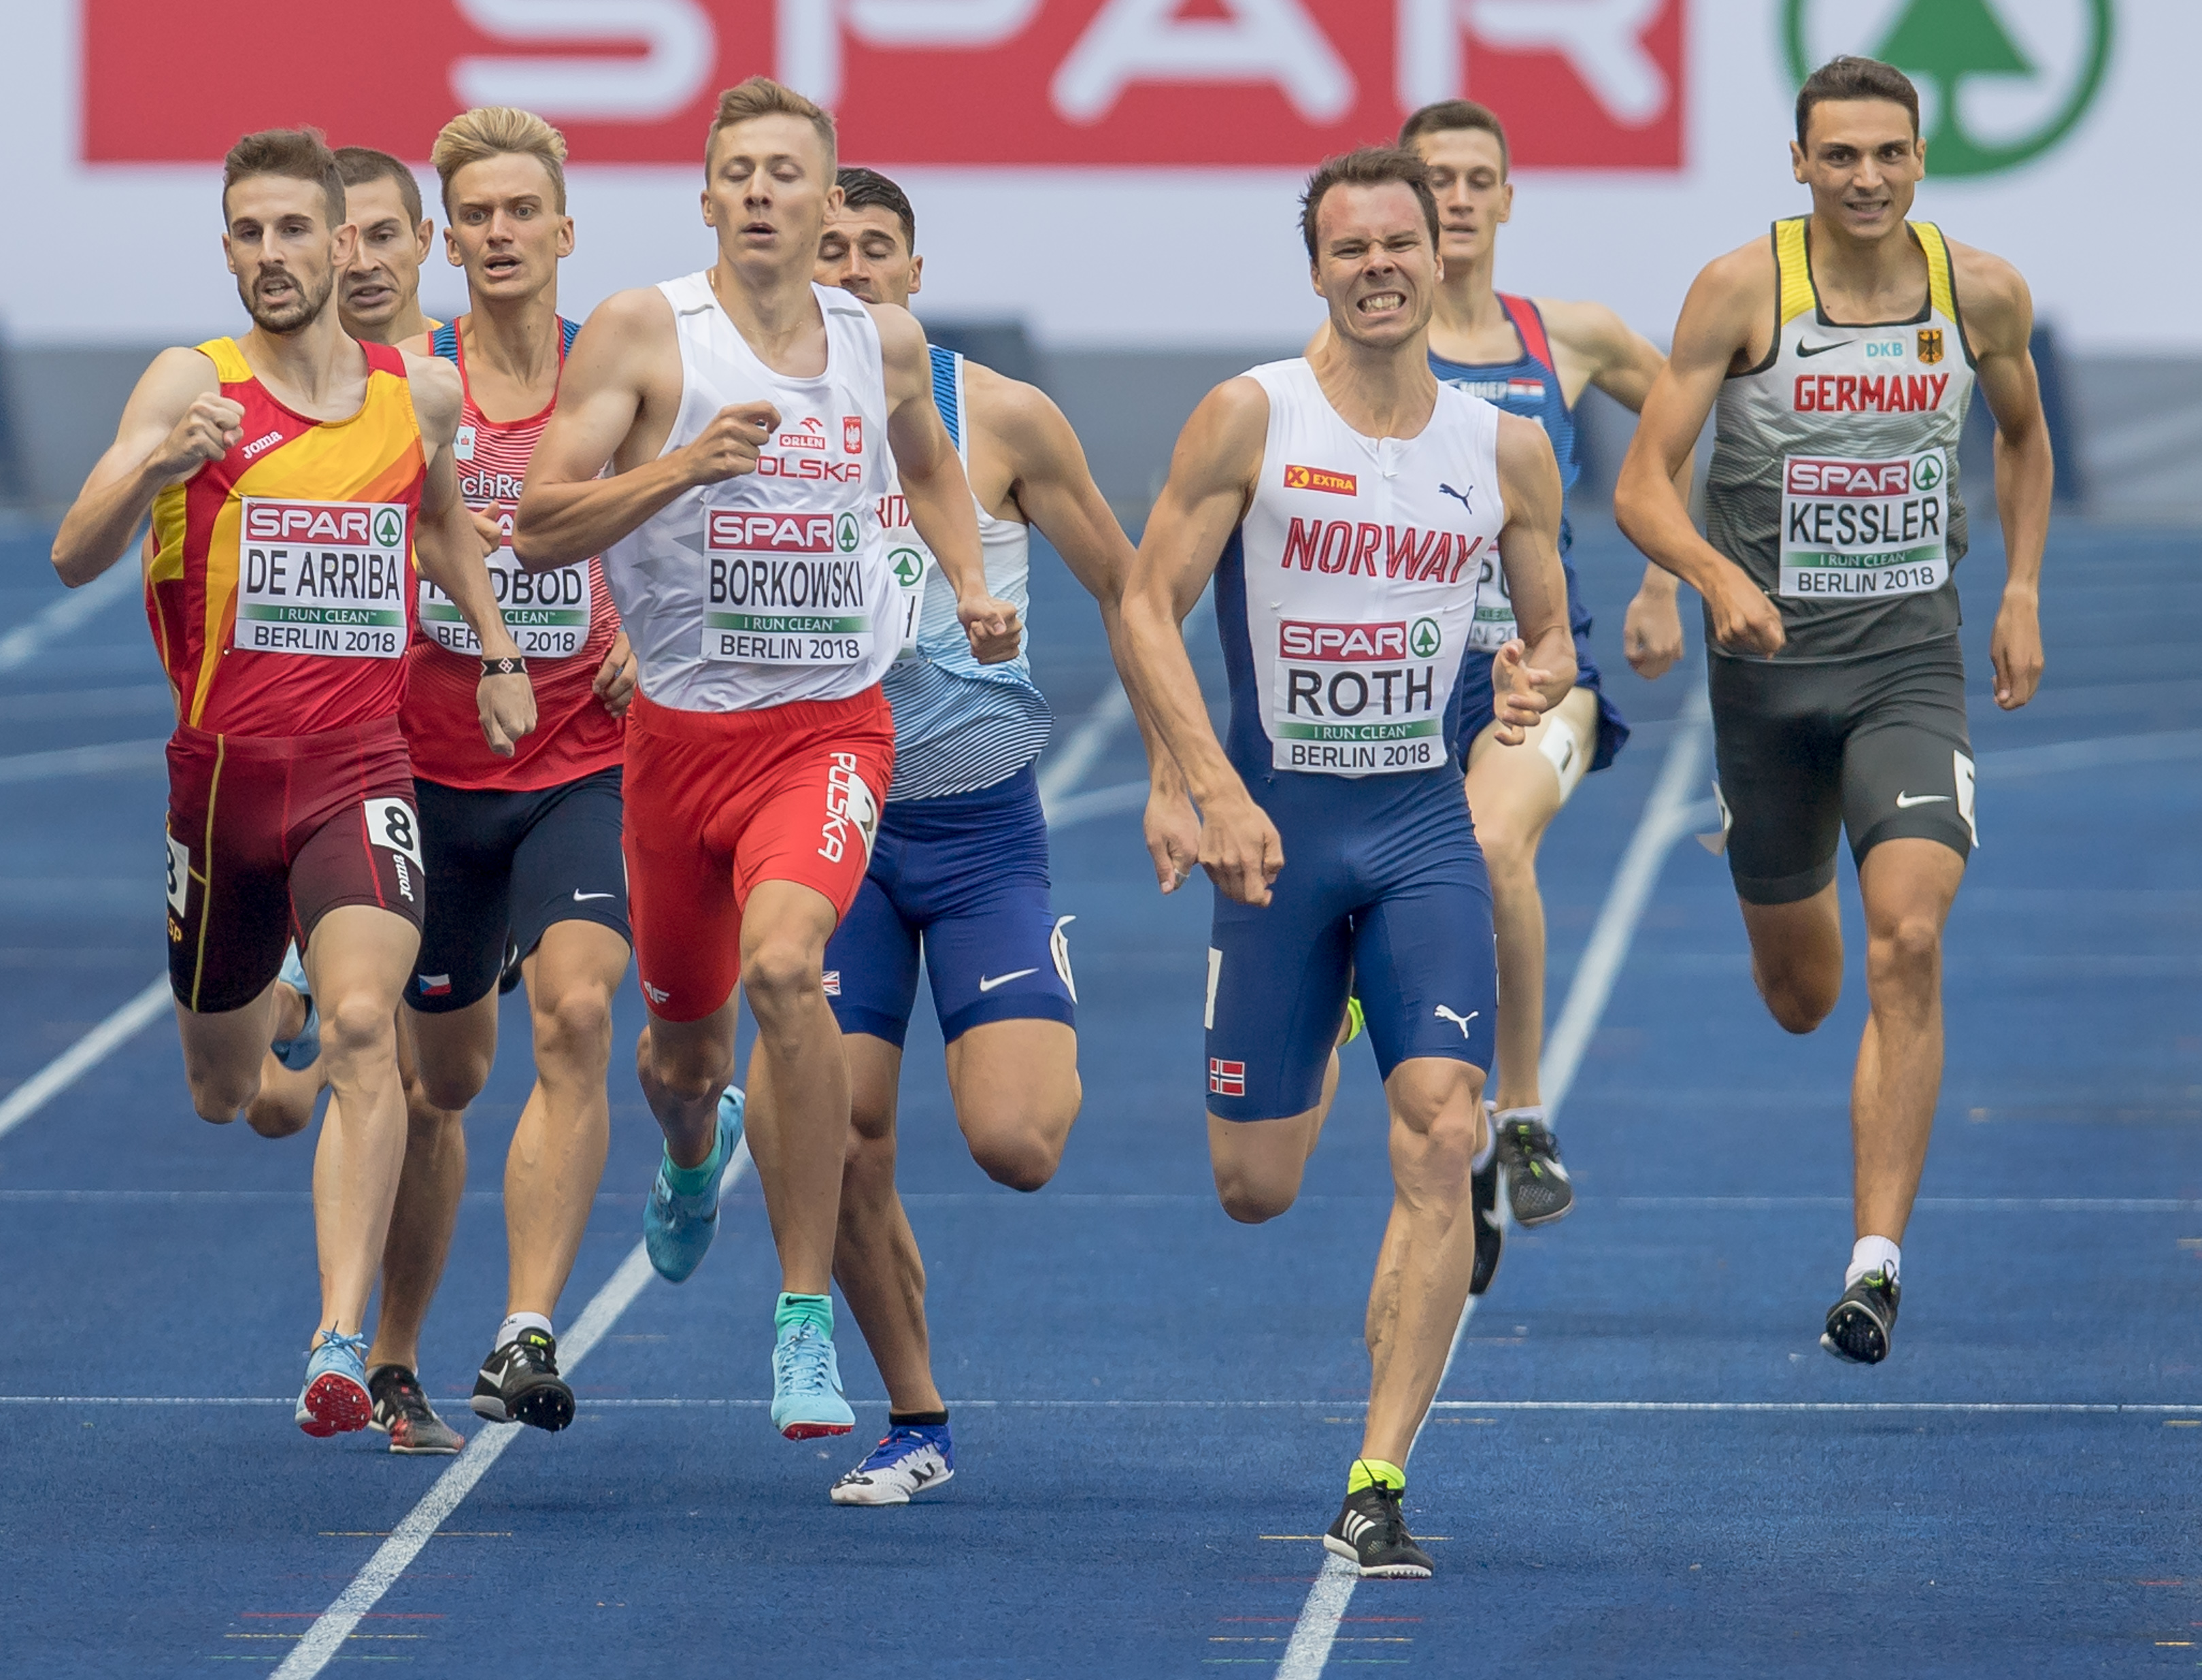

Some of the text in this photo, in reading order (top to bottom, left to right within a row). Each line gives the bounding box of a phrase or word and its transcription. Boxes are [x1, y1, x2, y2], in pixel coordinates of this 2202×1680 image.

[446, 0, 1675, 124] SPAR
[1866, 342, 1903, 358] DKB
[1793, 372, 1950, 412] GERMANY
[241, 431, 283, 460] Joma
[781, 435, 823, 448] ORLEN
[756, 455, 862, 484] OLSKA
[1313, 473, 1354, 490] EXTRA
[1790, 463, 1907, 492] SPAR
[250, 508, 368, 540] SPAR
[712, 516, 832, 548] SPAR
[1788, 496, 1939, 545] KESSLER
[1280, 516, 1483, 584] NORWAY
[1820, 554, 1824, 566] I
[1829, 554, 1859, 567] RUN
[246, 548, 401, 601] DE ARRIBA
[709, 558, 864, 609] BORKOWSKI
[1798, 566, 1935, 593] BERLIN 2018
[279, 607, 284, 620] I
[288, 609, 320, 622] RUN
[744, 616, 748, 628] I
[753, 617, 785, 630] RUN
[254, 625, 395, 653] BERLIN 2018
[525, 631, 575, 652] 2018
[720, 634, 860, 660] BERLIN 2018
[1282, 626, 1405, 657] SPAR
[1286, 665, 1434, 717] ROTH
[1314, 726, 1318, 739] I
[1323, 726, 1356, 739] RUN
[1292, 742, 1431, 768] BERLIN 2018
[817, 752, 856, 863] POLSKA
[384, 805, 414, 852] 8
[393, 853, 414, 903] Joma
